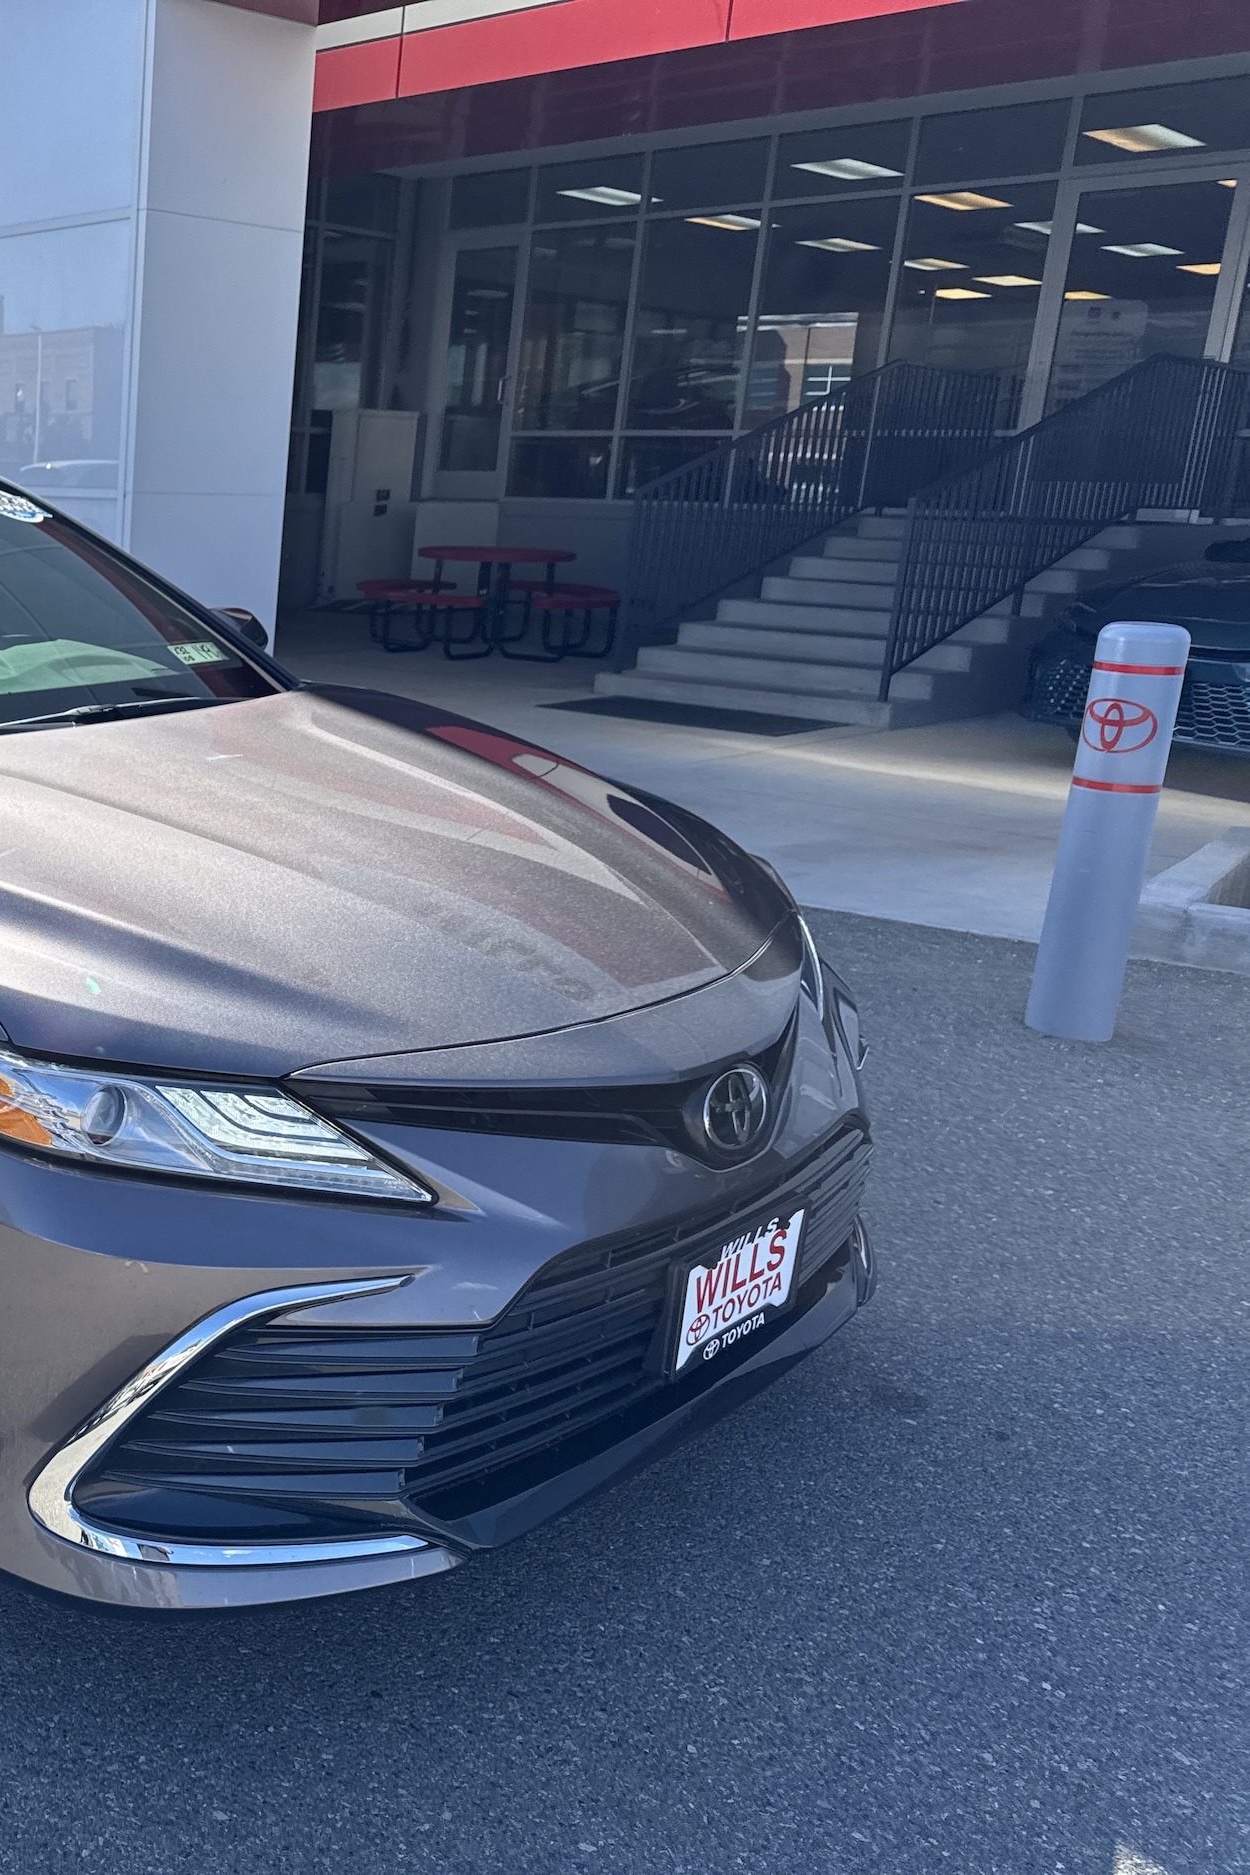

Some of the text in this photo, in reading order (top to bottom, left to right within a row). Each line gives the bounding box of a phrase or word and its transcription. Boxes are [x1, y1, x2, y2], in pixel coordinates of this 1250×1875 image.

[720, 1217, 779, 1260] WILLS
[696, 1229, 787, 1313] WILLS
[712, 1271, 782, 1330] TOYOTA
[721, 1312, 765, 1348] TOYOTA
